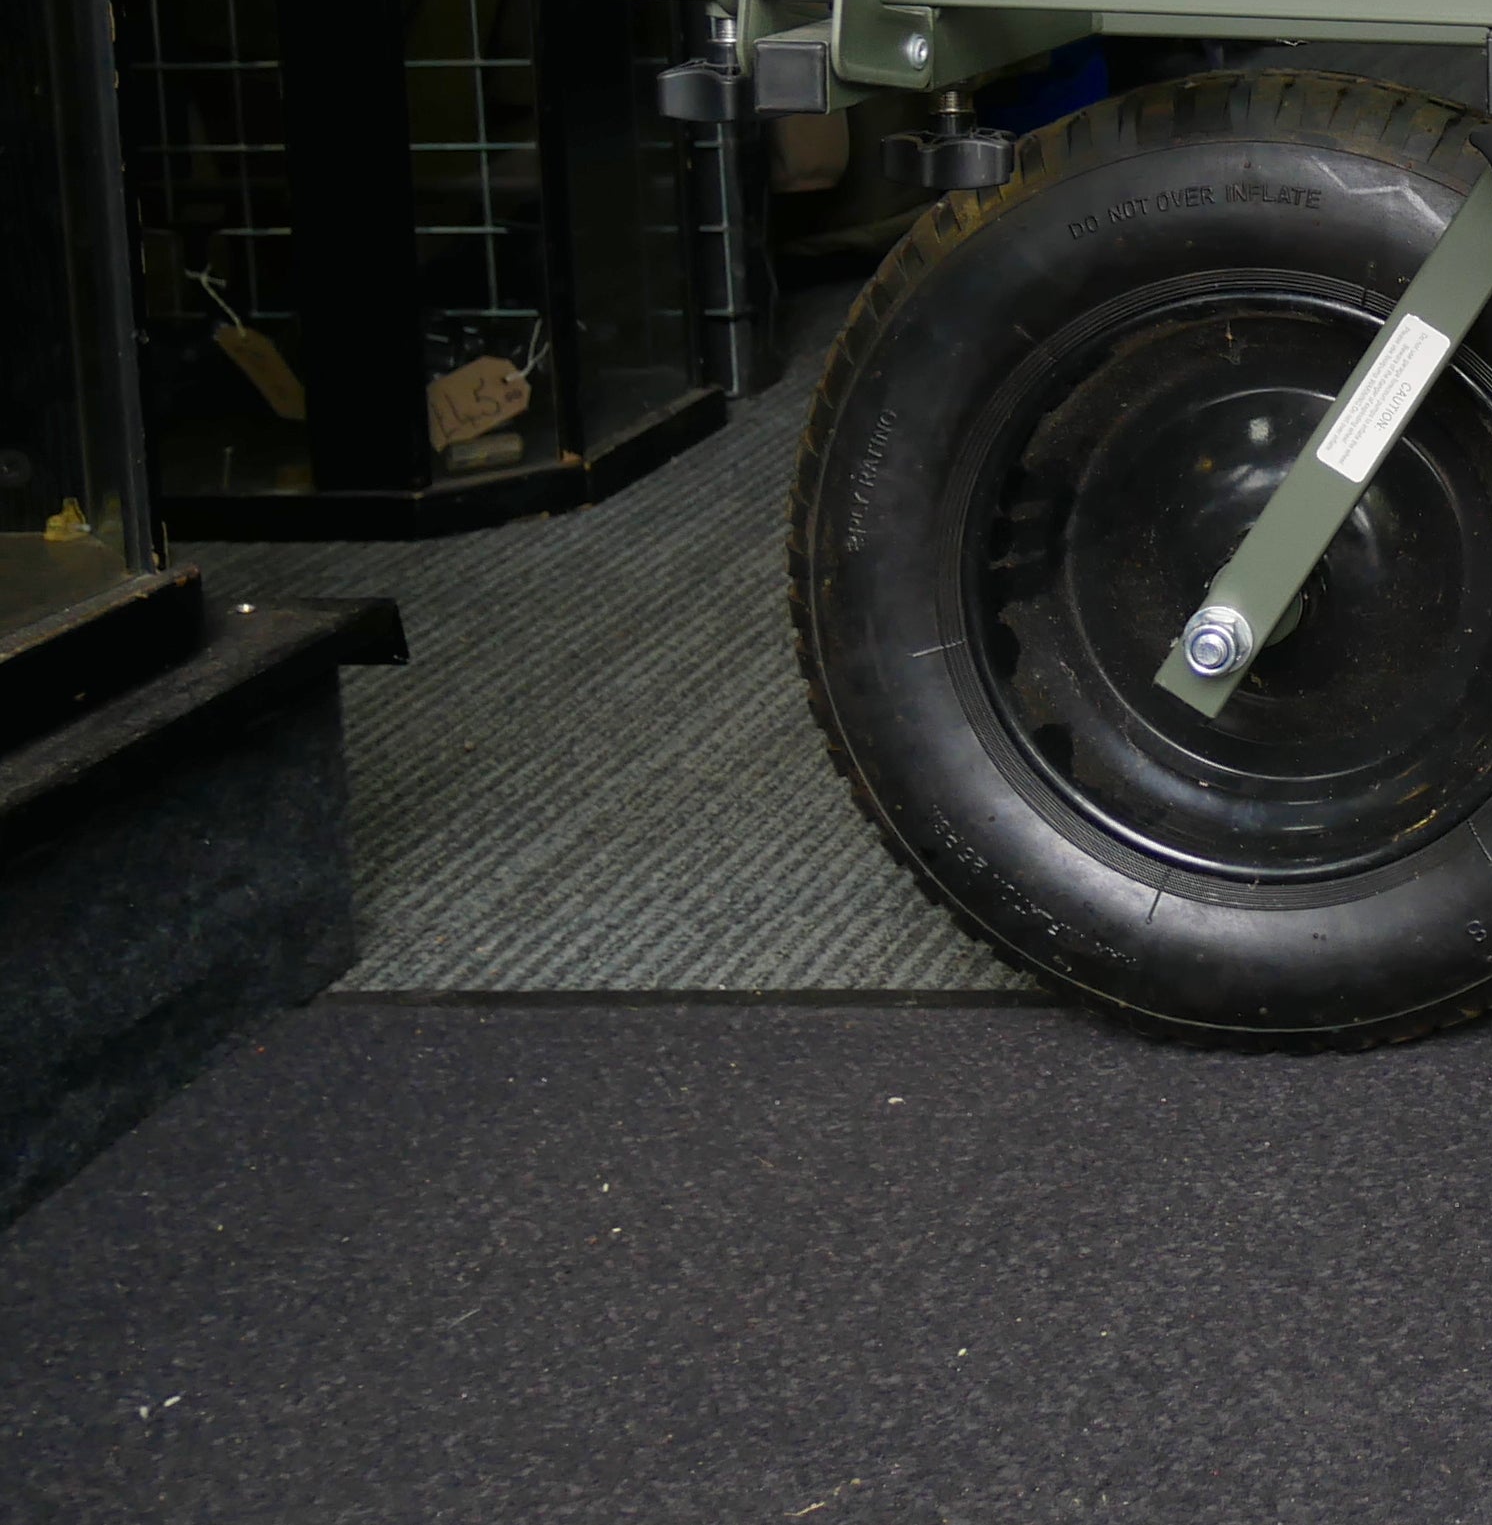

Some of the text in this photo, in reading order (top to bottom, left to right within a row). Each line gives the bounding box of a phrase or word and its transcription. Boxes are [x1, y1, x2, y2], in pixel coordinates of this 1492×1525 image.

[1067, 183, 1323, 240] DO NOT OVER INFLATE
[1375, 381, 1412, 431] CAUTION:
